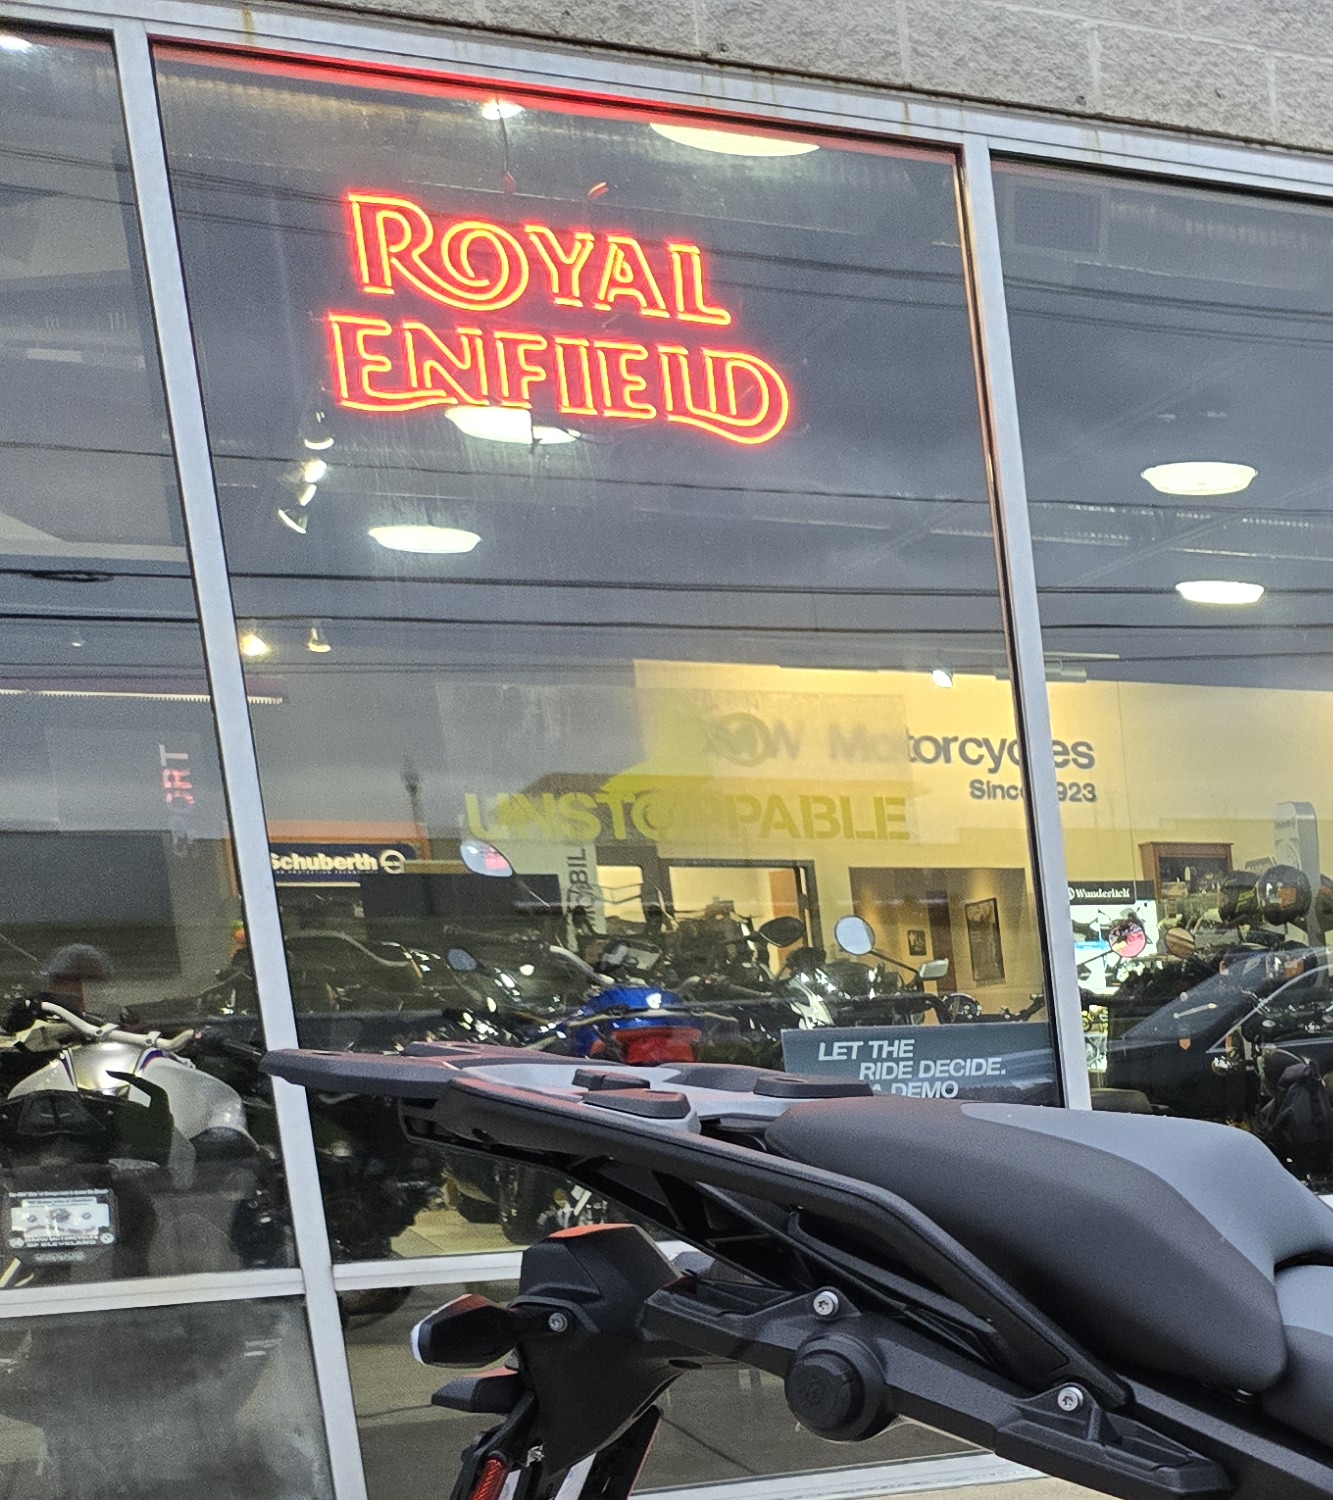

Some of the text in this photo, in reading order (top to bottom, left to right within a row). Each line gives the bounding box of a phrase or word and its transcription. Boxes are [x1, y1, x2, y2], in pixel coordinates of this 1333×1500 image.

[346, 192, 733, 327] ROYAL
[326, 311, 790, 446] ENFIELD
[968, 778, 1098, 803] Sinc 923
[270, 852, 378, 871] Schuberth
[818, 1038, 915, 1061] LET THE
[858, 1057, 1006, 1081] RIDE DECIDE.
